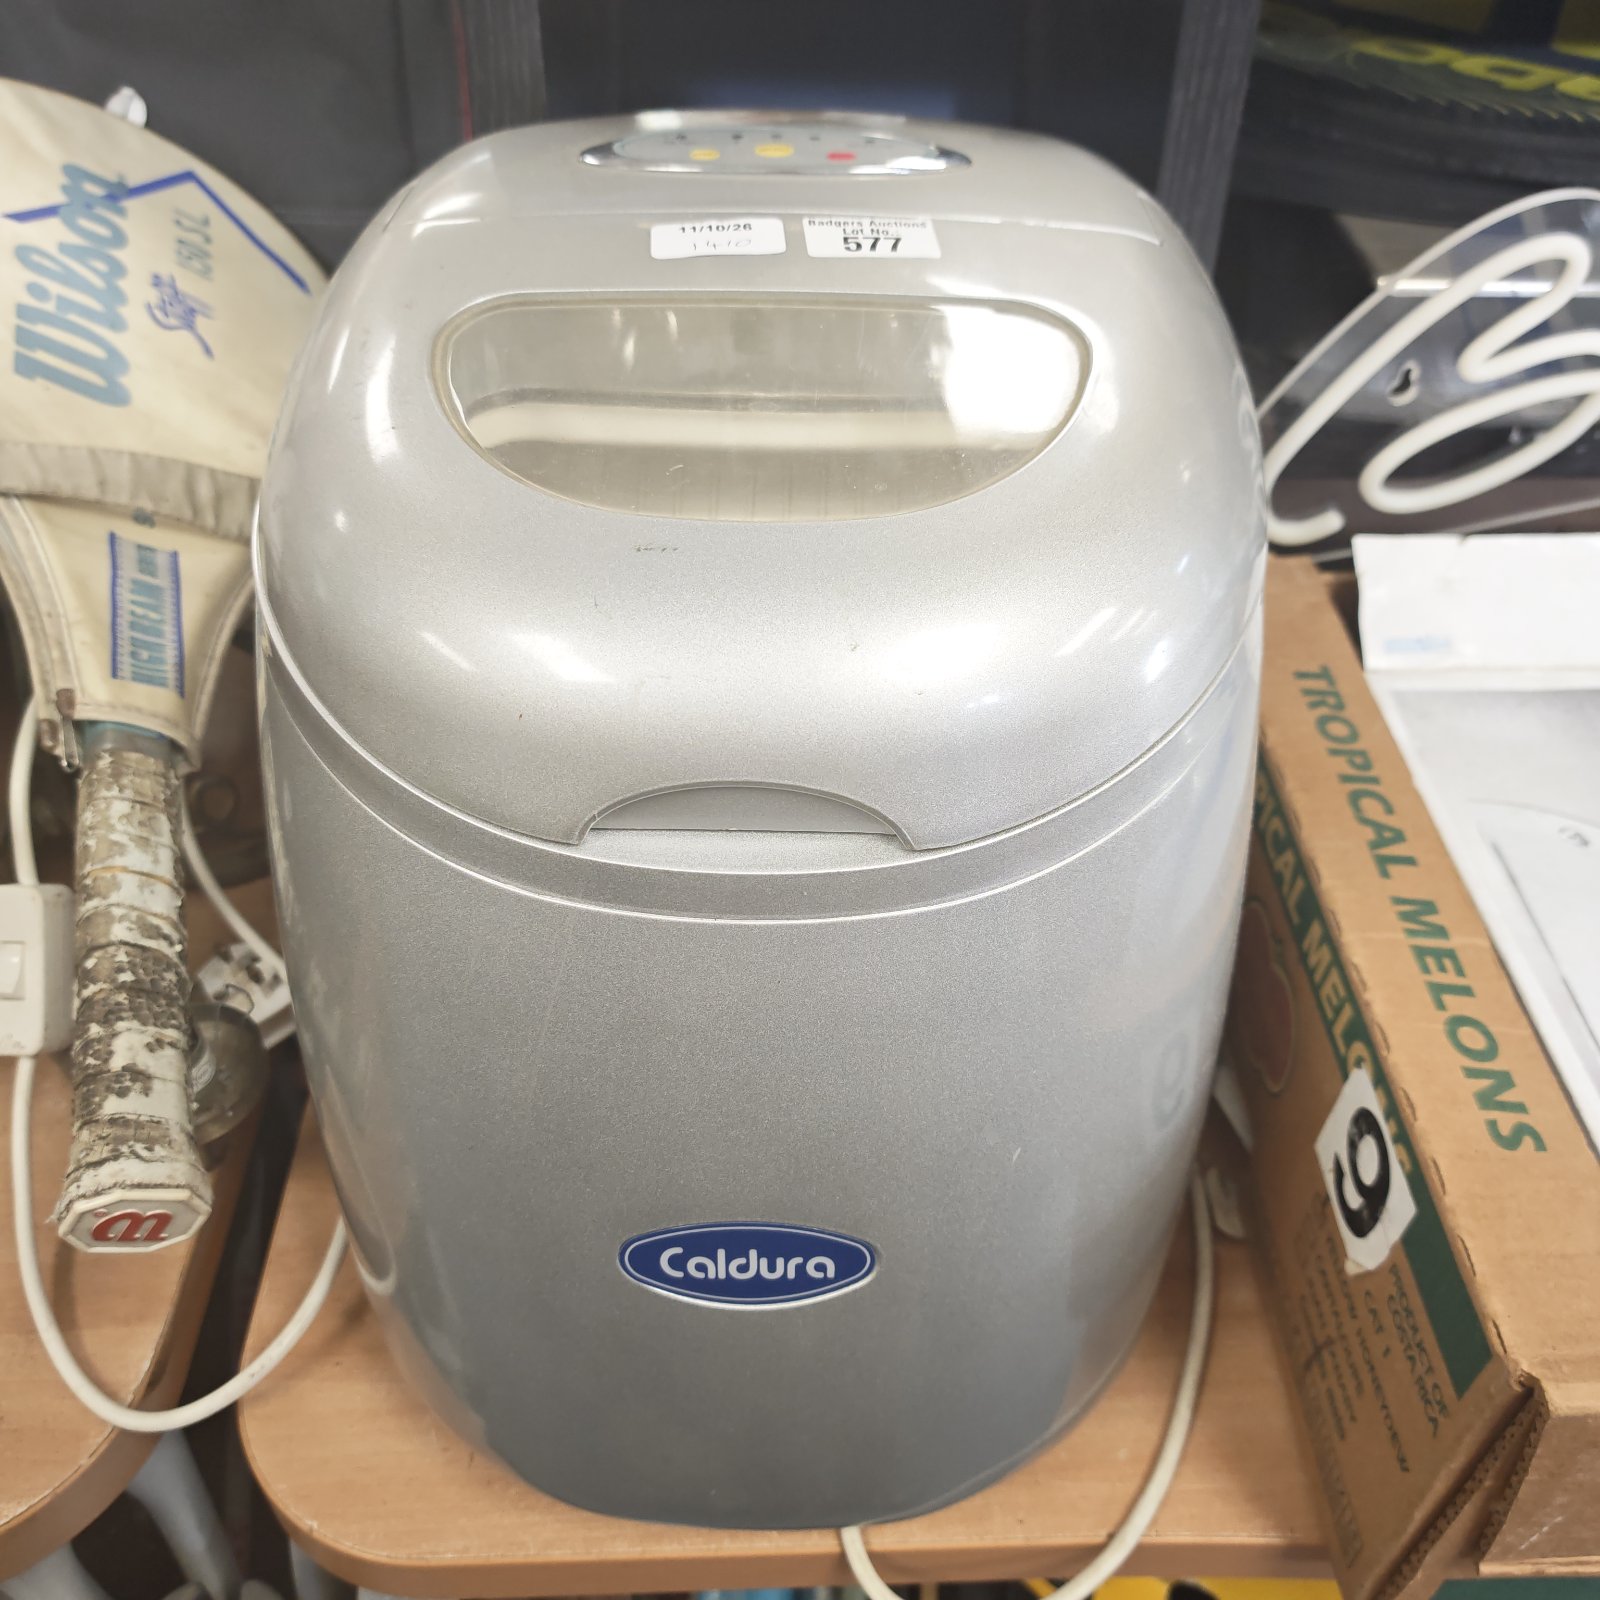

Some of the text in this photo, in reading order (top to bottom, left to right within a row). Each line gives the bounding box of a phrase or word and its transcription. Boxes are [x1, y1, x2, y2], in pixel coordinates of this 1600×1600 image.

[842, 228, 864, 236] Lot
[842, 236, 902, 252] 577
[13, 163, 133, 408] Wilson
[1292, 664, 1418, 880] TROPICAL
[1389, 896, 1548, 1152] MELONS
[659, 1246, 836, 1280] Caldura
[1356, 1326, 1410, 1473] HONEYDEW
